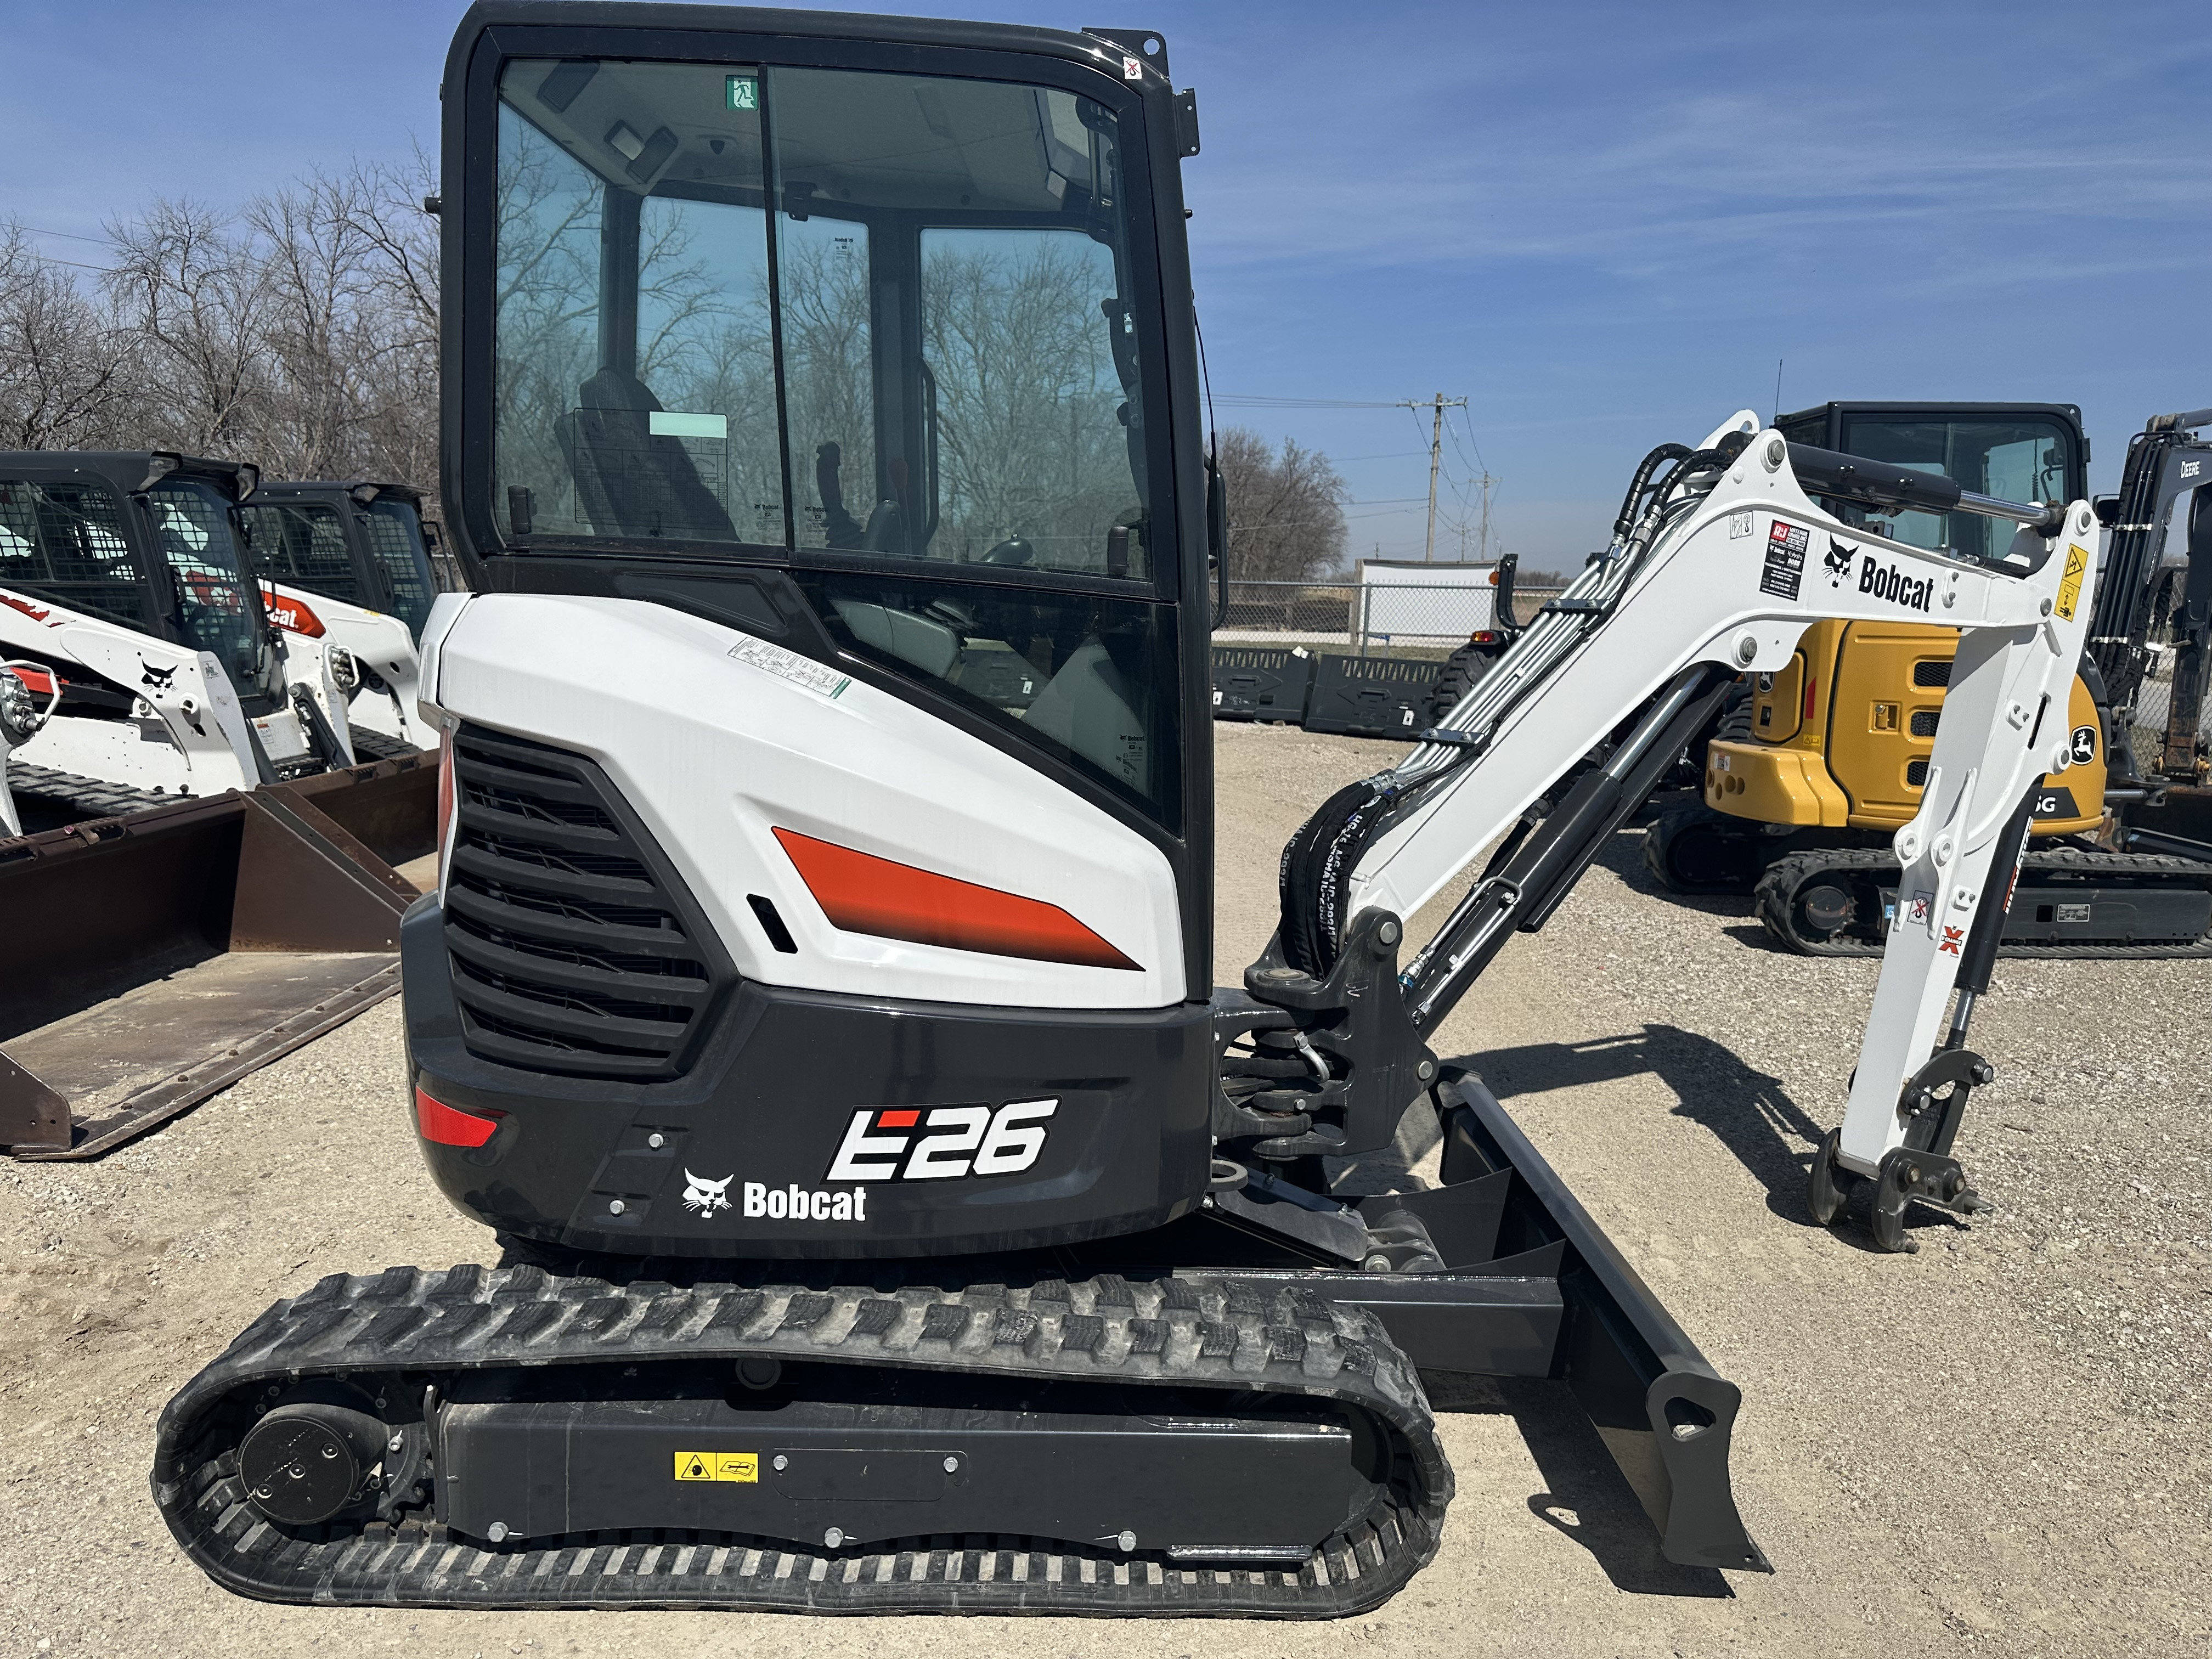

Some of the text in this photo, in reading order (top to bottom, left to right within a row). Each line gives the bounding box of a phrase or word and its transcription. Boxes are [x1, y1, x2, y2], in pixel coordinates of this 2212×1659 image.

[2180, 461, 2200, 478] DEERE
[1858, 555, 1933, 613] Bobcat
[827, 1099, 1059, 1180] E26
[744, 1182, 866, 1221] Bobcat
